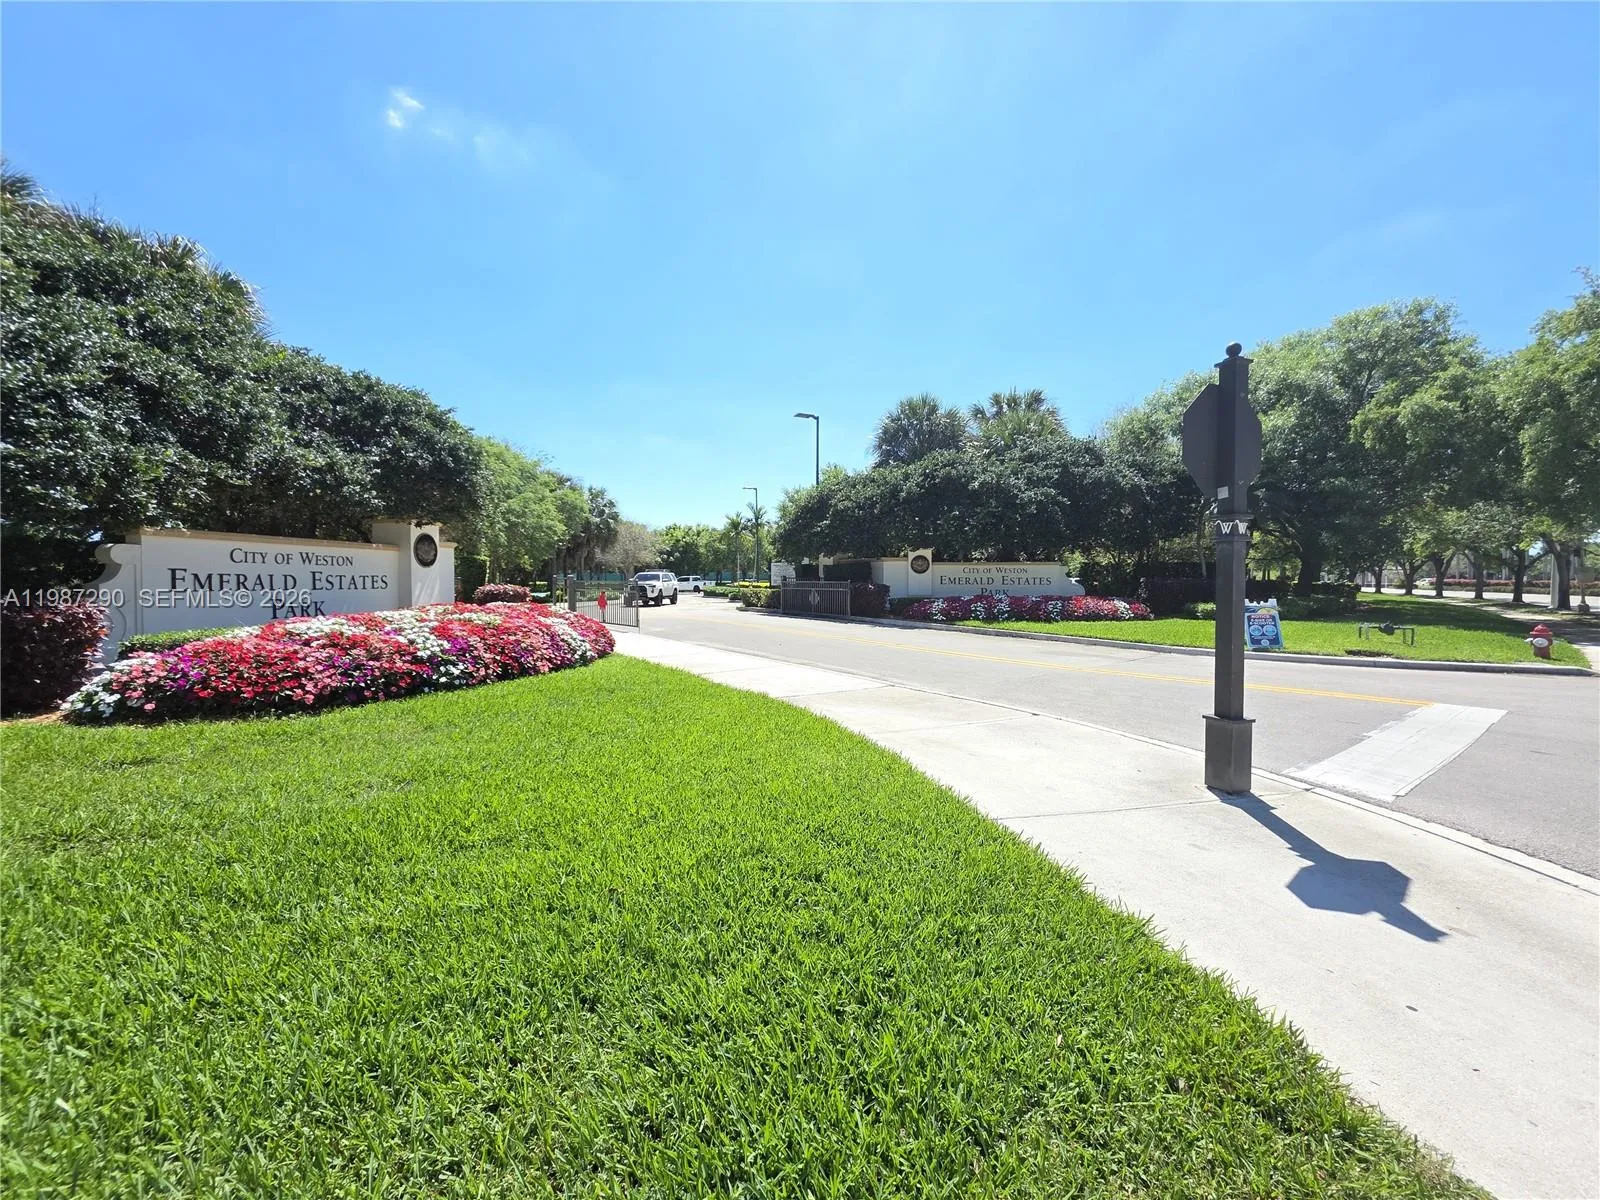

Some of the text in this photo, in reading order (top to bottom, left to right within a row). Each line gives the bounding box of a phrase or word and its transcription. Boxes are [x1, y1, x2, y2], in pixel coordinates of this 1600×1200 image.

[229, 548, 353, 567] CITY OF WESTON
[167, 568, 389, 592] EMERALD ESTATES
[940, 575, 1052, 586] EMERALD ESTATES
[981, 587, 1010, 597] PARK
[271, 599, 326, 620] PARK
